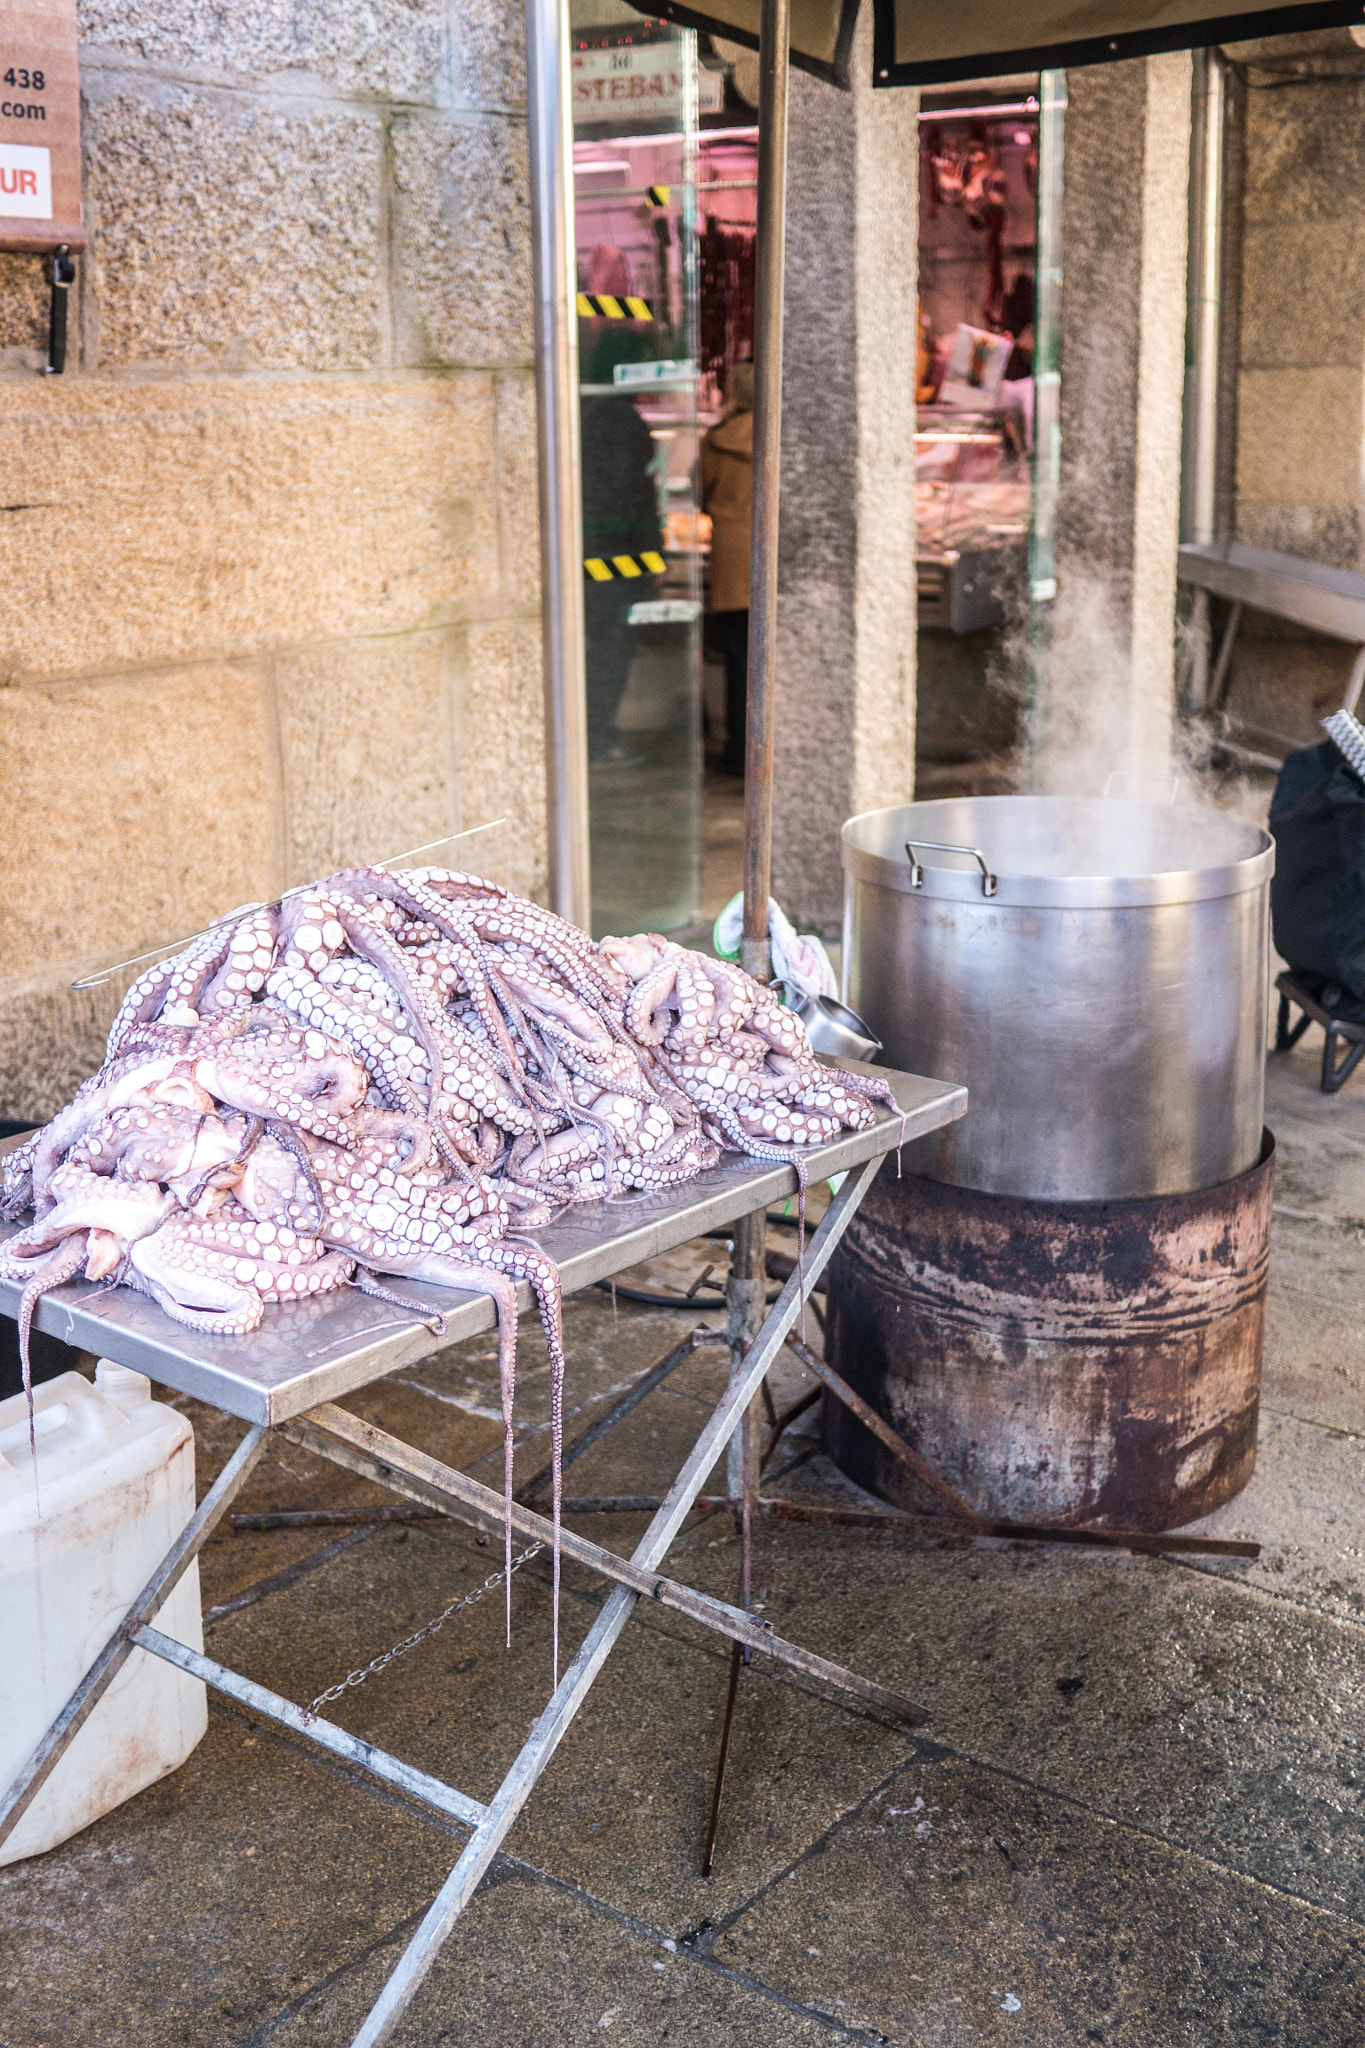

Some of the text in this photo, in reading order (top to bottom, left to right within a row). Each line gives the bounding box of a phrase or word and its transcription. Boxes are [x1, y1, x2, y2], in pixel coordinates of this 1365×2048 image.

[4, 67, 46, 91] 438
[1, 101, 46, 120] com
[0, 167, 37, 195] UR
